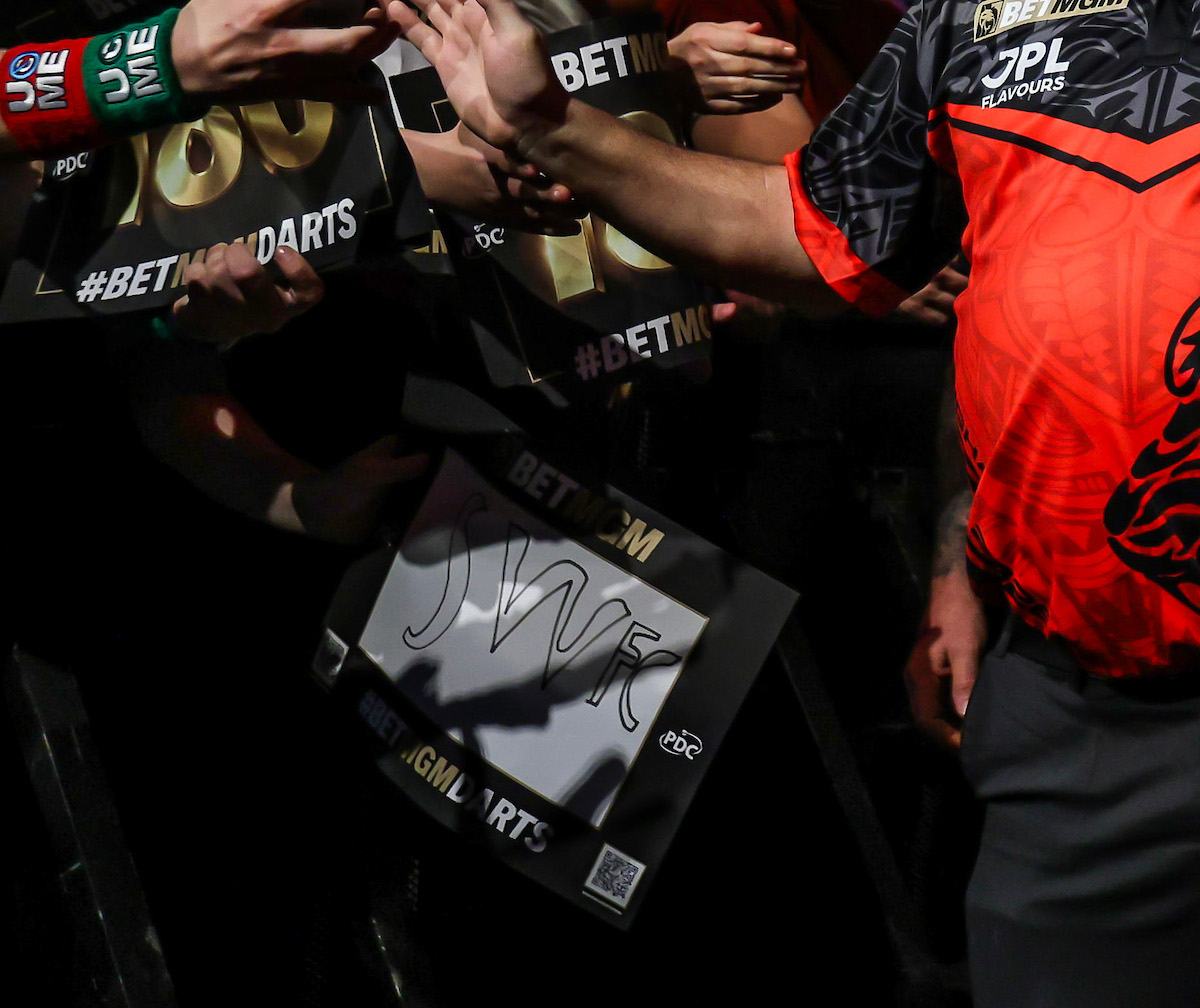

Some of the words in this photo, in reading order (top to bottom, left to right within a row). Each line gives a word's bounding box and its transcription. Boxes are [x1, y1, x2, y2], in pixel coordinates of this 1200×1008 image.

[982, 37, 1070, 90] JPL
[981, 76, 1065, 110] FLAVOURS
[53, 151, 89, 180] PDC
[76, 197, 358, 304] #BETMDARTS
[659, 729, 704, 760] PDC
